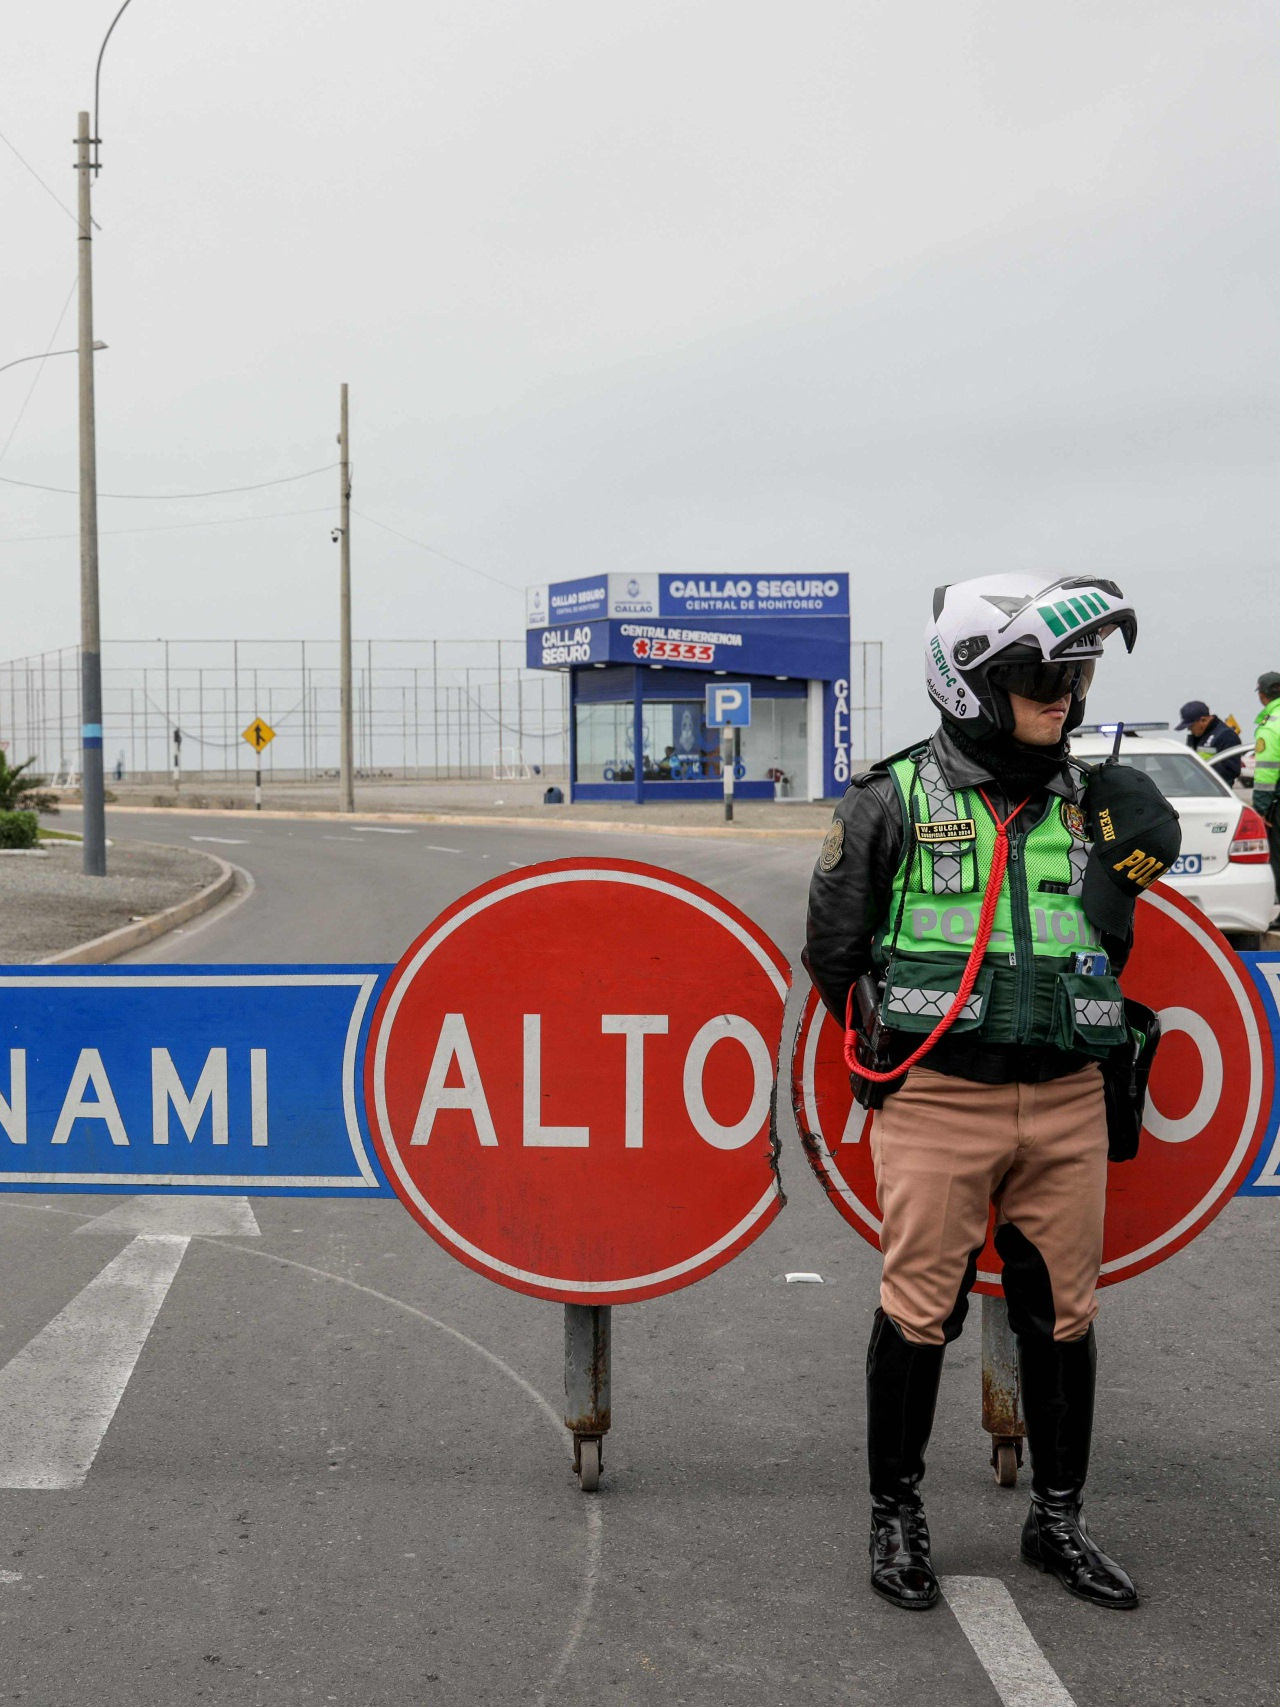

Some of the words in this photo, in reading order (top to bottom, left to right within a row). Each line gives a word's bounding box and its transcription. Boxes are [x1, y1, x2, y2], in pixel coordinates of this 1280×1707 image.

[550, 593, 577, 608] CALLAO
[577, 588, 606, 604] SEGURO
[669, 580, 752, 598] CALLAO
[756, 579, 839, 598] SEGURO
[615, 605, 653, 613] CALLAO
[686, 601, 737, 610] CENTRAL
[740, 601, 755, 610] DE
[758, 600, 823, 610] MONITOREO
[542, 626, 591, 647] CALLAO
[620, 624, 667, 639] CENTRAL
[667, 628, 681, 641] DE
[682, 629, 743, 646] EMERGENCIA
[542, 643, 591, 665] SEGURO
[929, 635, 957, 688] UTSEVI-C
[715, 689, 742, 722] P
[954, 699, 967, 717] 19
[834, 679, 849, 783] CALLAO
[933, 824, 958, 833] SULCA
[1098, 808, 1116, 841] PERU
[409, 1012, 776, 1151] ALTO
